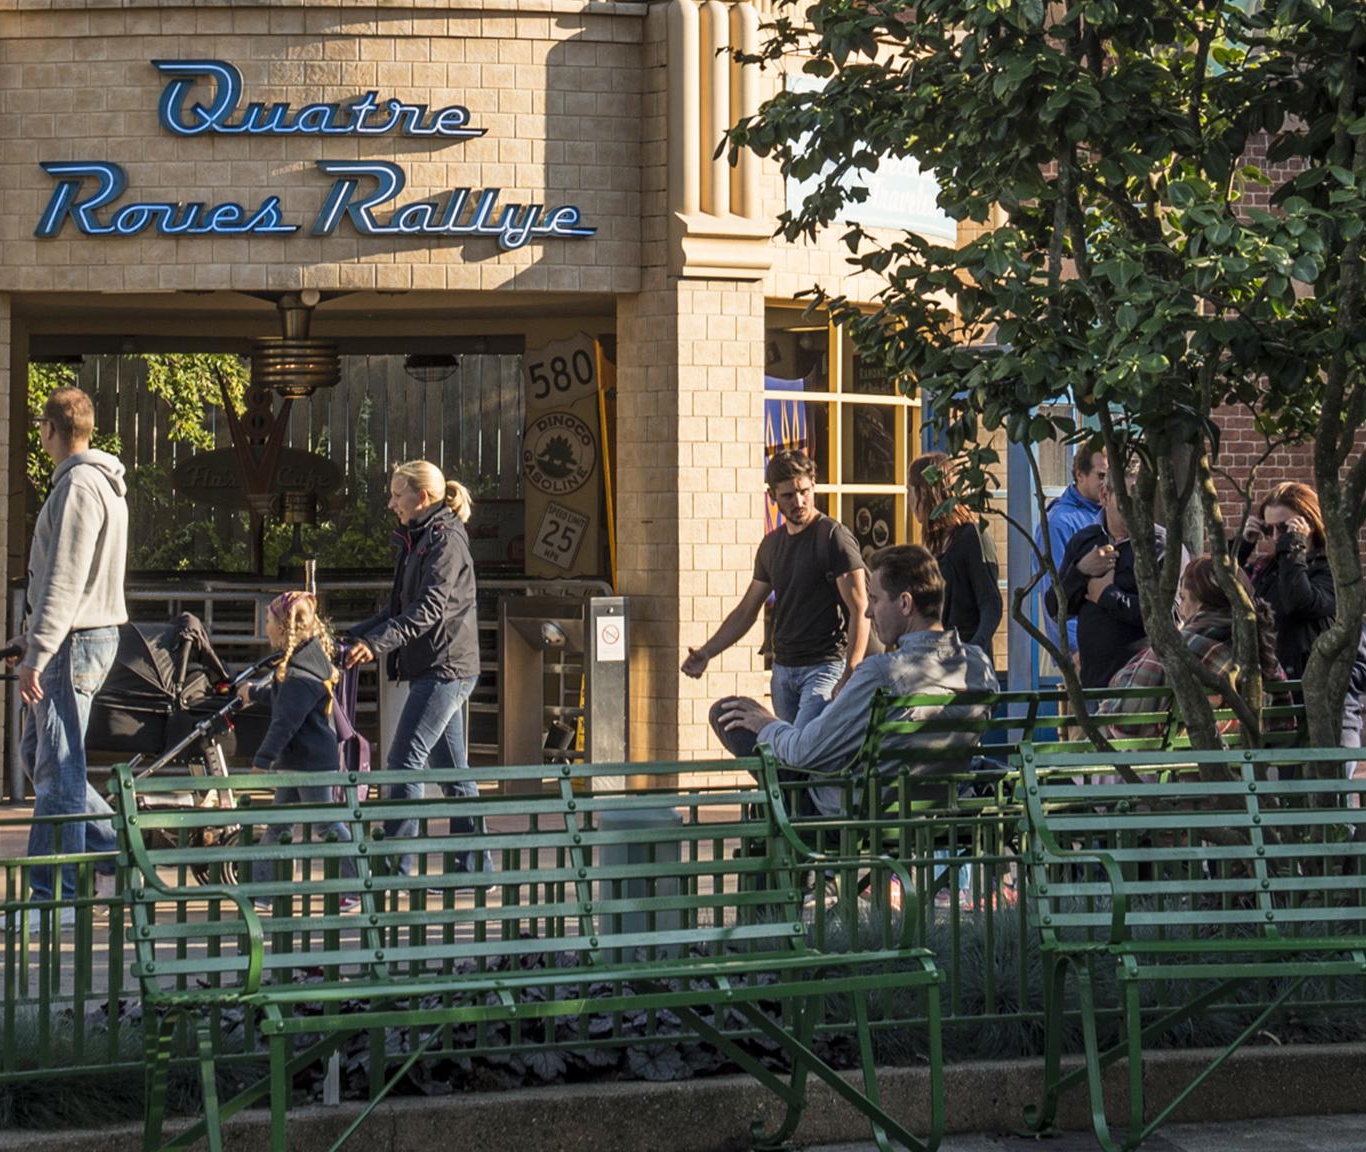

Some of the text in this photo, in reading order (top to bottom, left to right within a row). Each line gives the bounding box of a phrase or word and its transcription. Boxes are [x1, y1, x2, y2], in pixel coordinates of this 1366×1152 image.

[151, 58, 489, 138] Quatre
[34, 159, 599, 250] Roues Rallye
[528, 348, 594, 399] 580
[536, 414, 591, 448] DINOCO
[523, 449, 588, 493] GASOLINE
[541, 519, 576, 553] 25
[548, 504, 587, 529] SPEED LIMIT
